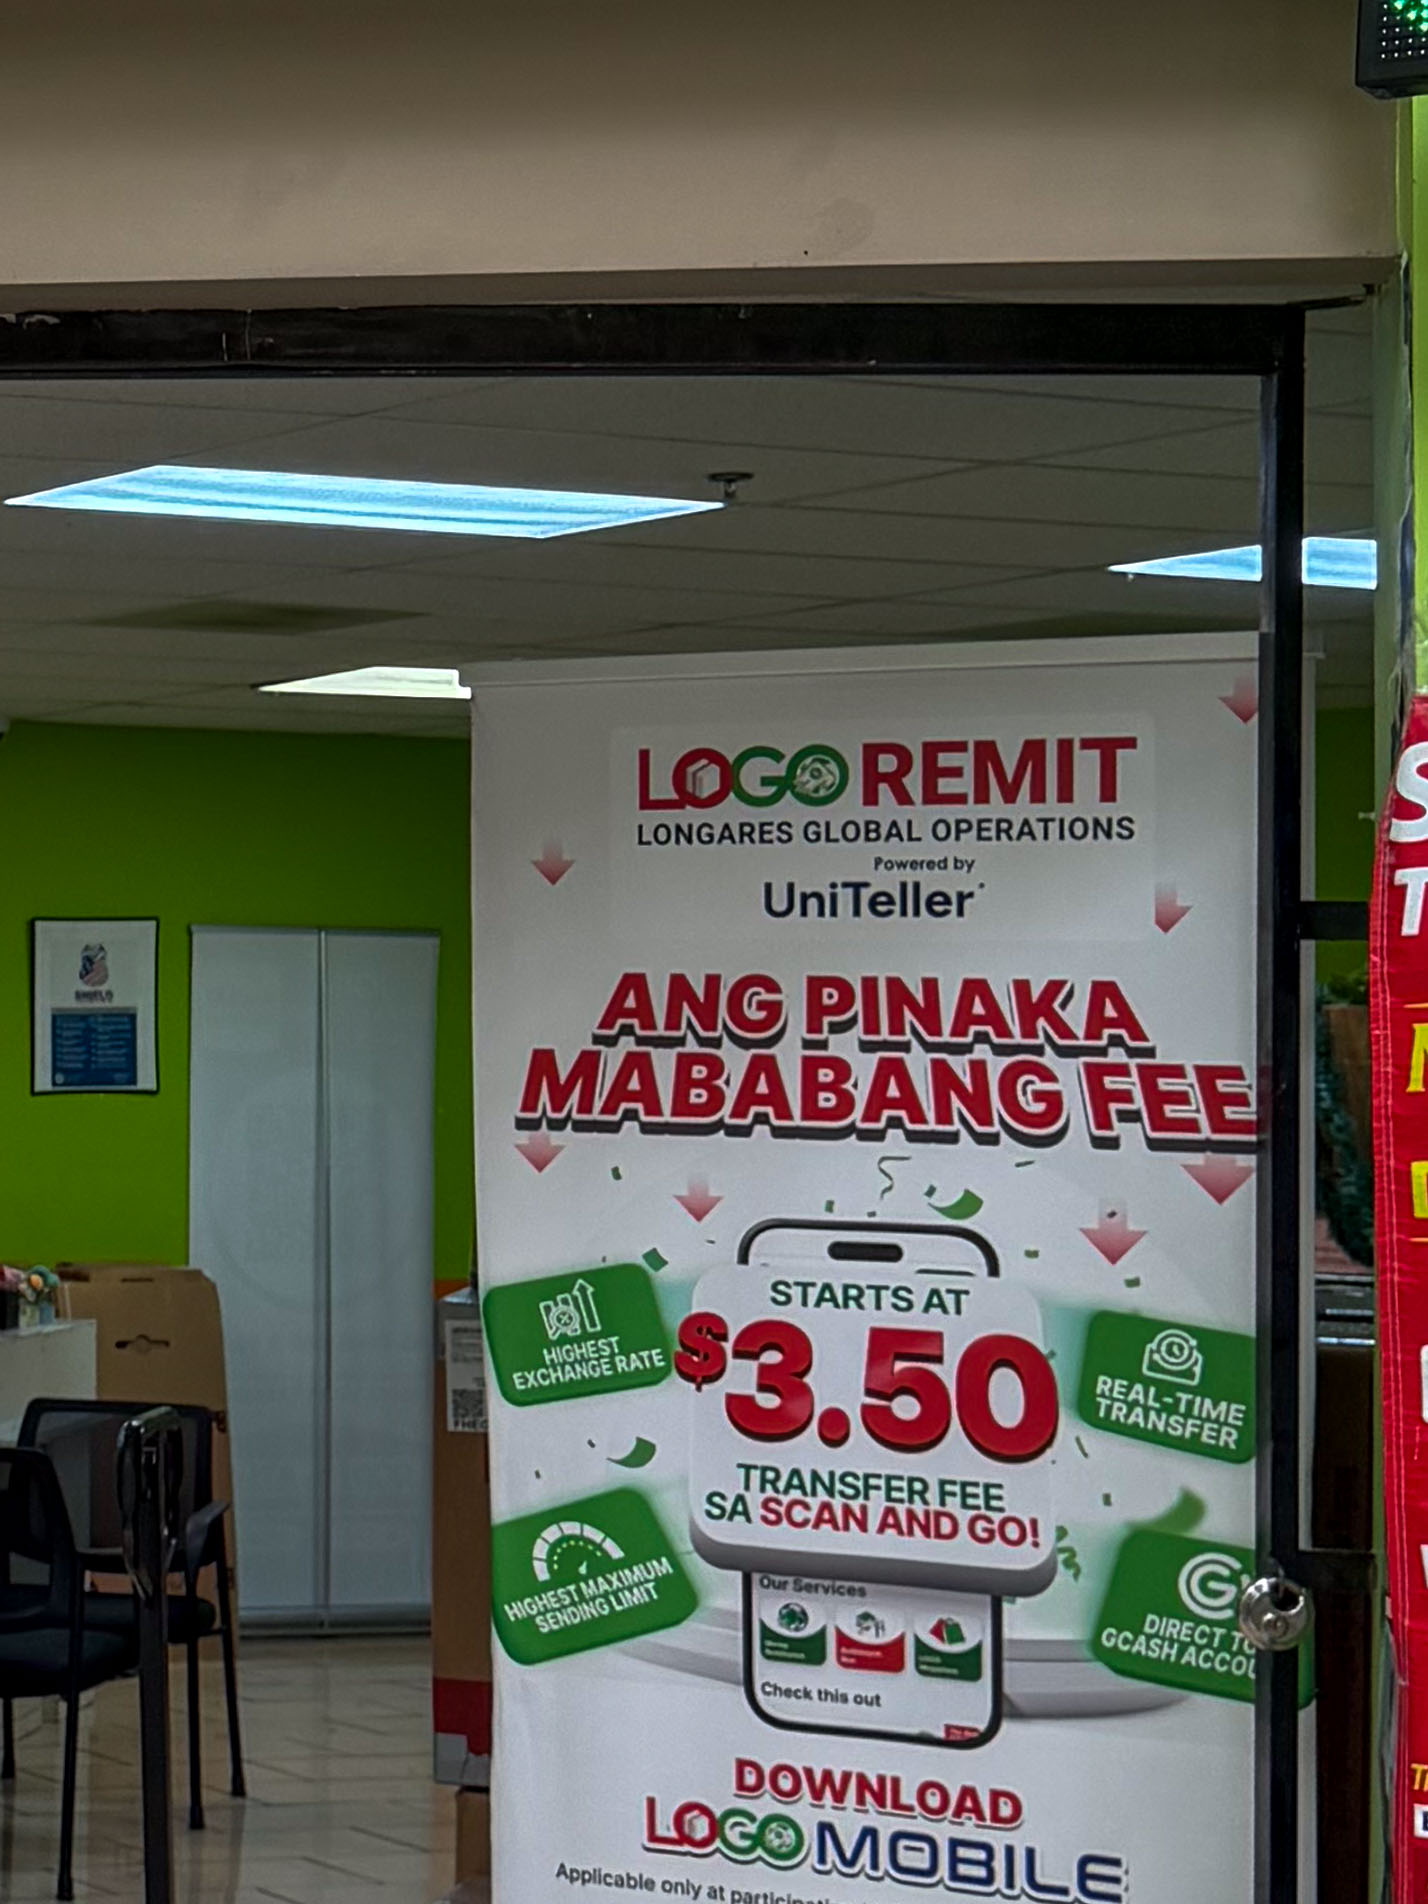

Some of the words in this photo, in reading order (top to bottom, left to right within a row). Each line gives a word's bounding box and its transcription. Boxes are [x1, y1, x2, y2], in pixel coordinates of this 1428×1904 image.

[637, 743, 850, 812] LOGO
[861, 736, 1139, 807] REMIT
[636, 819, 793, 847] LONGARES
[802, 818, 923, 845] GLOBAL
[931, 815, 1136, 843] OPERATIONS
[873, 856, 951, 871] Powered
[955, 855, 976, 874] by
[762, 881, 976, 919] UniTeller
[593, 971, 789, 1049] ANG
[802, 975, 1156, 1060] PINAKA
[514, 1048, 1070, 1149] MABABANG
[1079, 1059, 1260, 1153] FEE
[769, 1279, 914, 1313] STARTS
[920, 1288, 971, 1316] AT
[512, 1357, 614, 1391] EXCHANGE
[616, 1348, 666, 1374] RATE
[543, 1336, 621, 1366] HIGHEST
[673, 1312, 1061, 1466] $3.50
[1096, 1375, 1247, 1427] REAL-TIME
[1096, 1397, 1239, 1450] TRANSFER
[736, 1463, 931, 1507] TRANSFER
[938, 1476, 1005, 1513] FEE
[705, 1490, 754, 1525] SA
[760, 1499, 870, 1538] SCAN
[875, 1506, 959, 1542] AND
[966, 1511, 1042, 1549] GO!
[503, 1587, 584, 1622] HIGHEST
[581, 1556, 674, 1595] MAXIMUM
[535, 1598, 611, 1634] SENDING
[609, 1582, 659, 1613] LIMIT
[759, 1574, 789, 1590] Our
[793, 1578, 867, 1598] Services
[1100, 1627, 1181, 1663] GCASH
[1144, 1614, 1228, 1649] DIRECT
[761, 1681, 813, 1702] Check
[817, 1687, 849, 1704] this
[853, 1692, 882, 1707] out
[734, 1757, 1022, 1827] DOWNLOAD
[644, 1795, 805, 1867] LOGO
[815, 1821, 1125, 1904] MOBILE
[555, 1862, 656, 1893] Applicable
[660, 1878, 702, 1902] only
[706, 1886, 726, 1902] at
